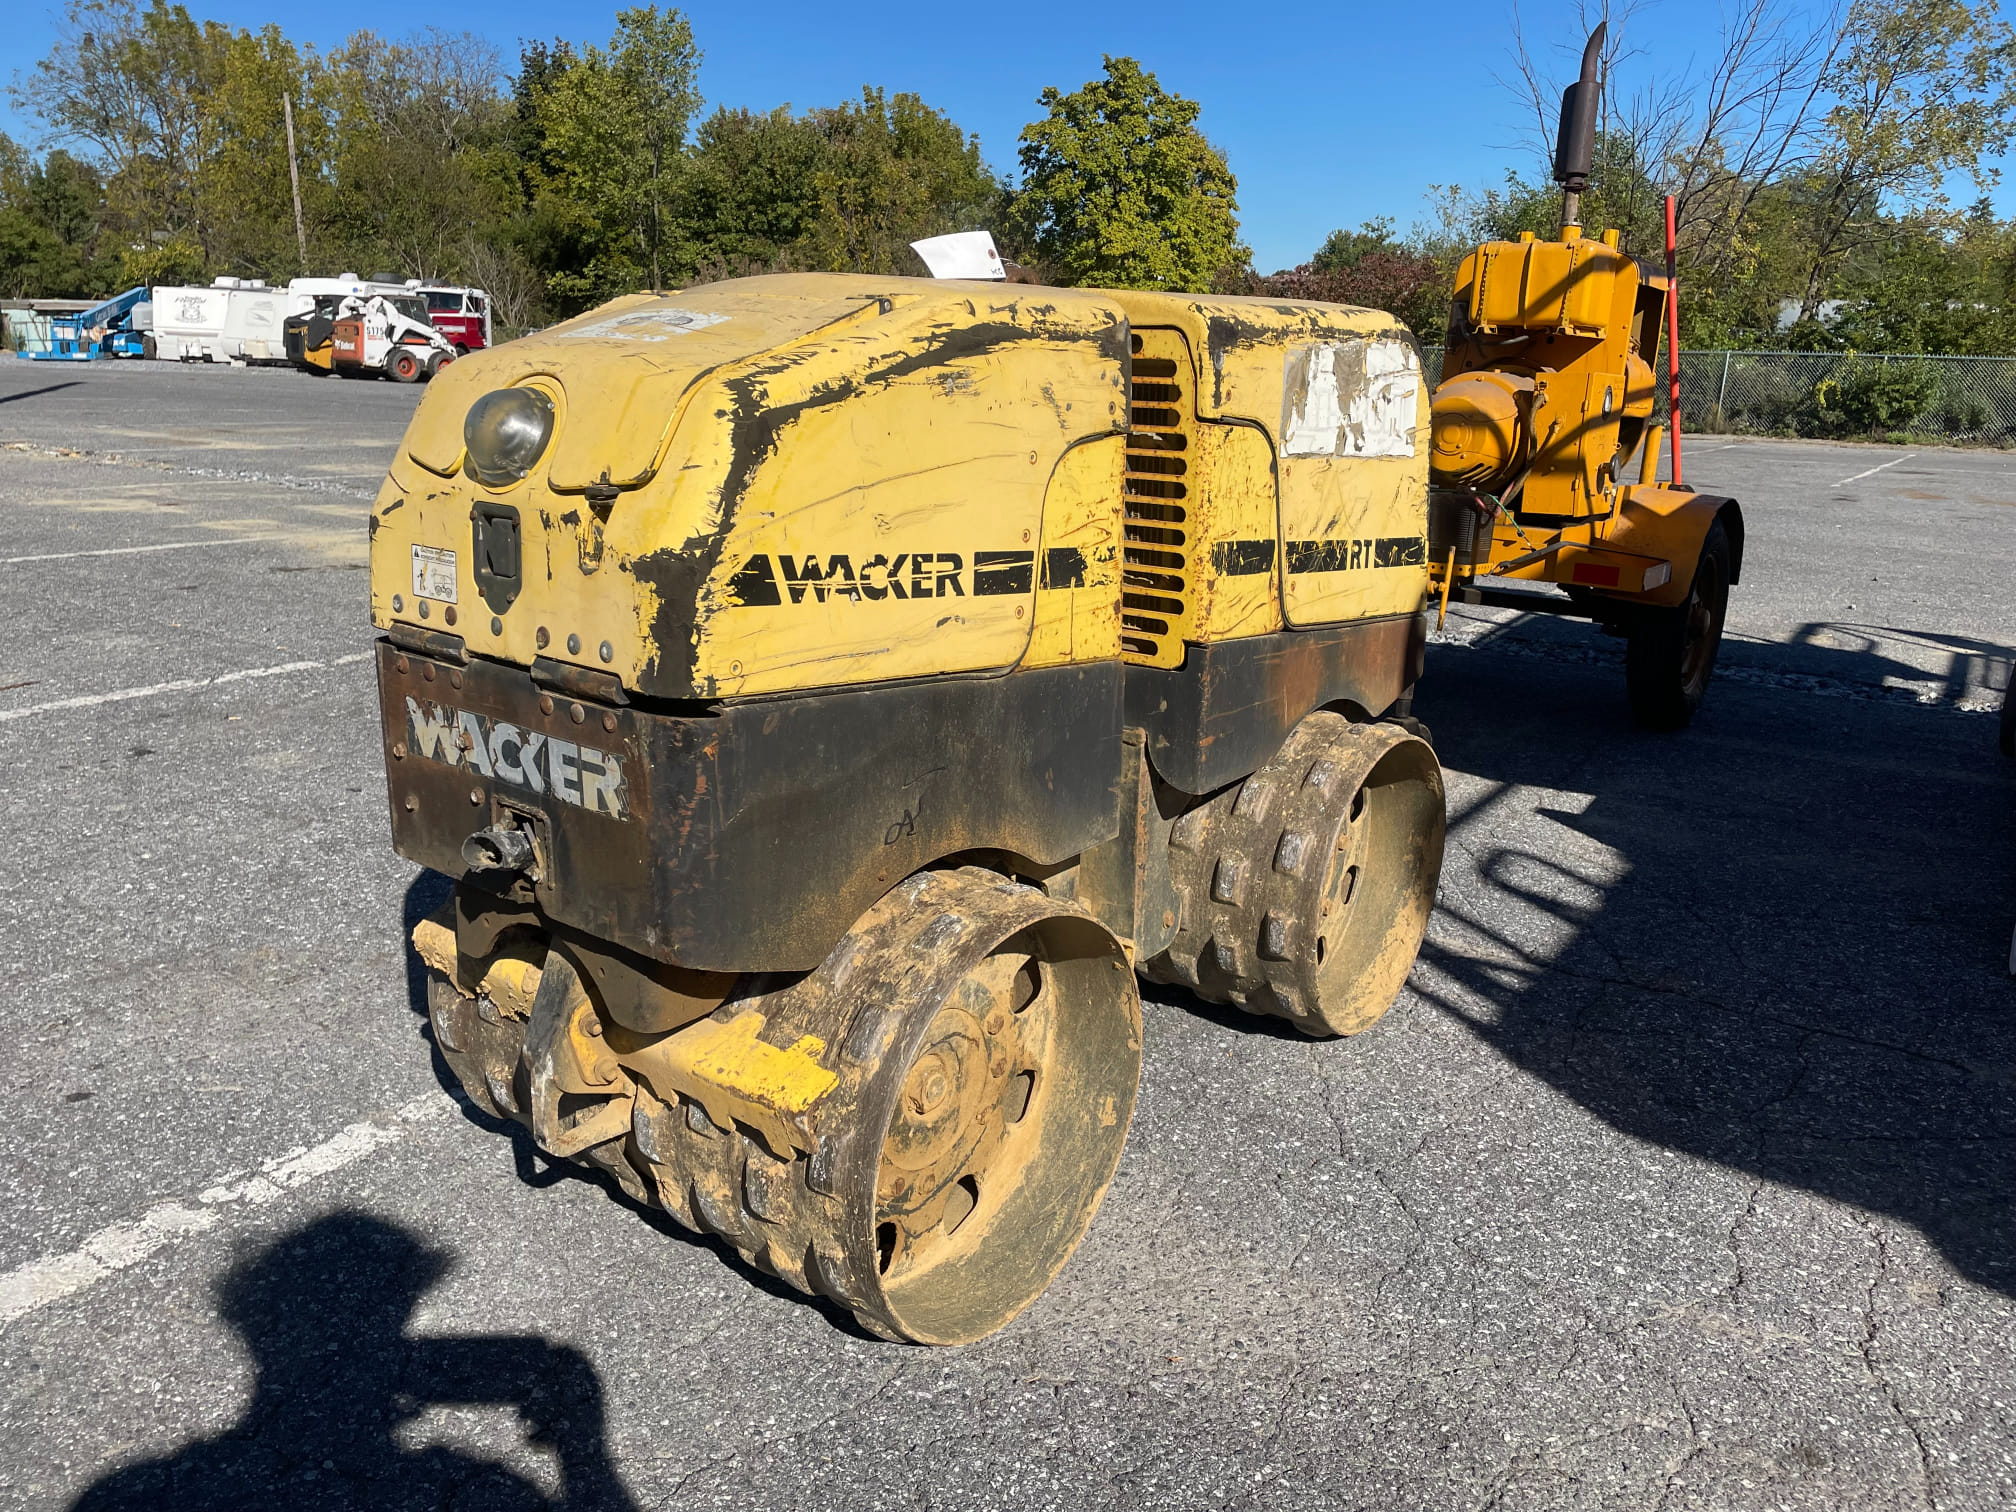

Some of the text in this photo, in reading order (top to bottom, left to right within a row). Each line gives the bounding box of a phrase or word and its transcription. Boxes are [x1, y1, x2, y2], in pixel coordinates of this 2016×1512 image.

[778, 551, 965, 603] WACKER
[1350, 540, 1373, 569] RT
[405, 695, 623, 819] WACKER
